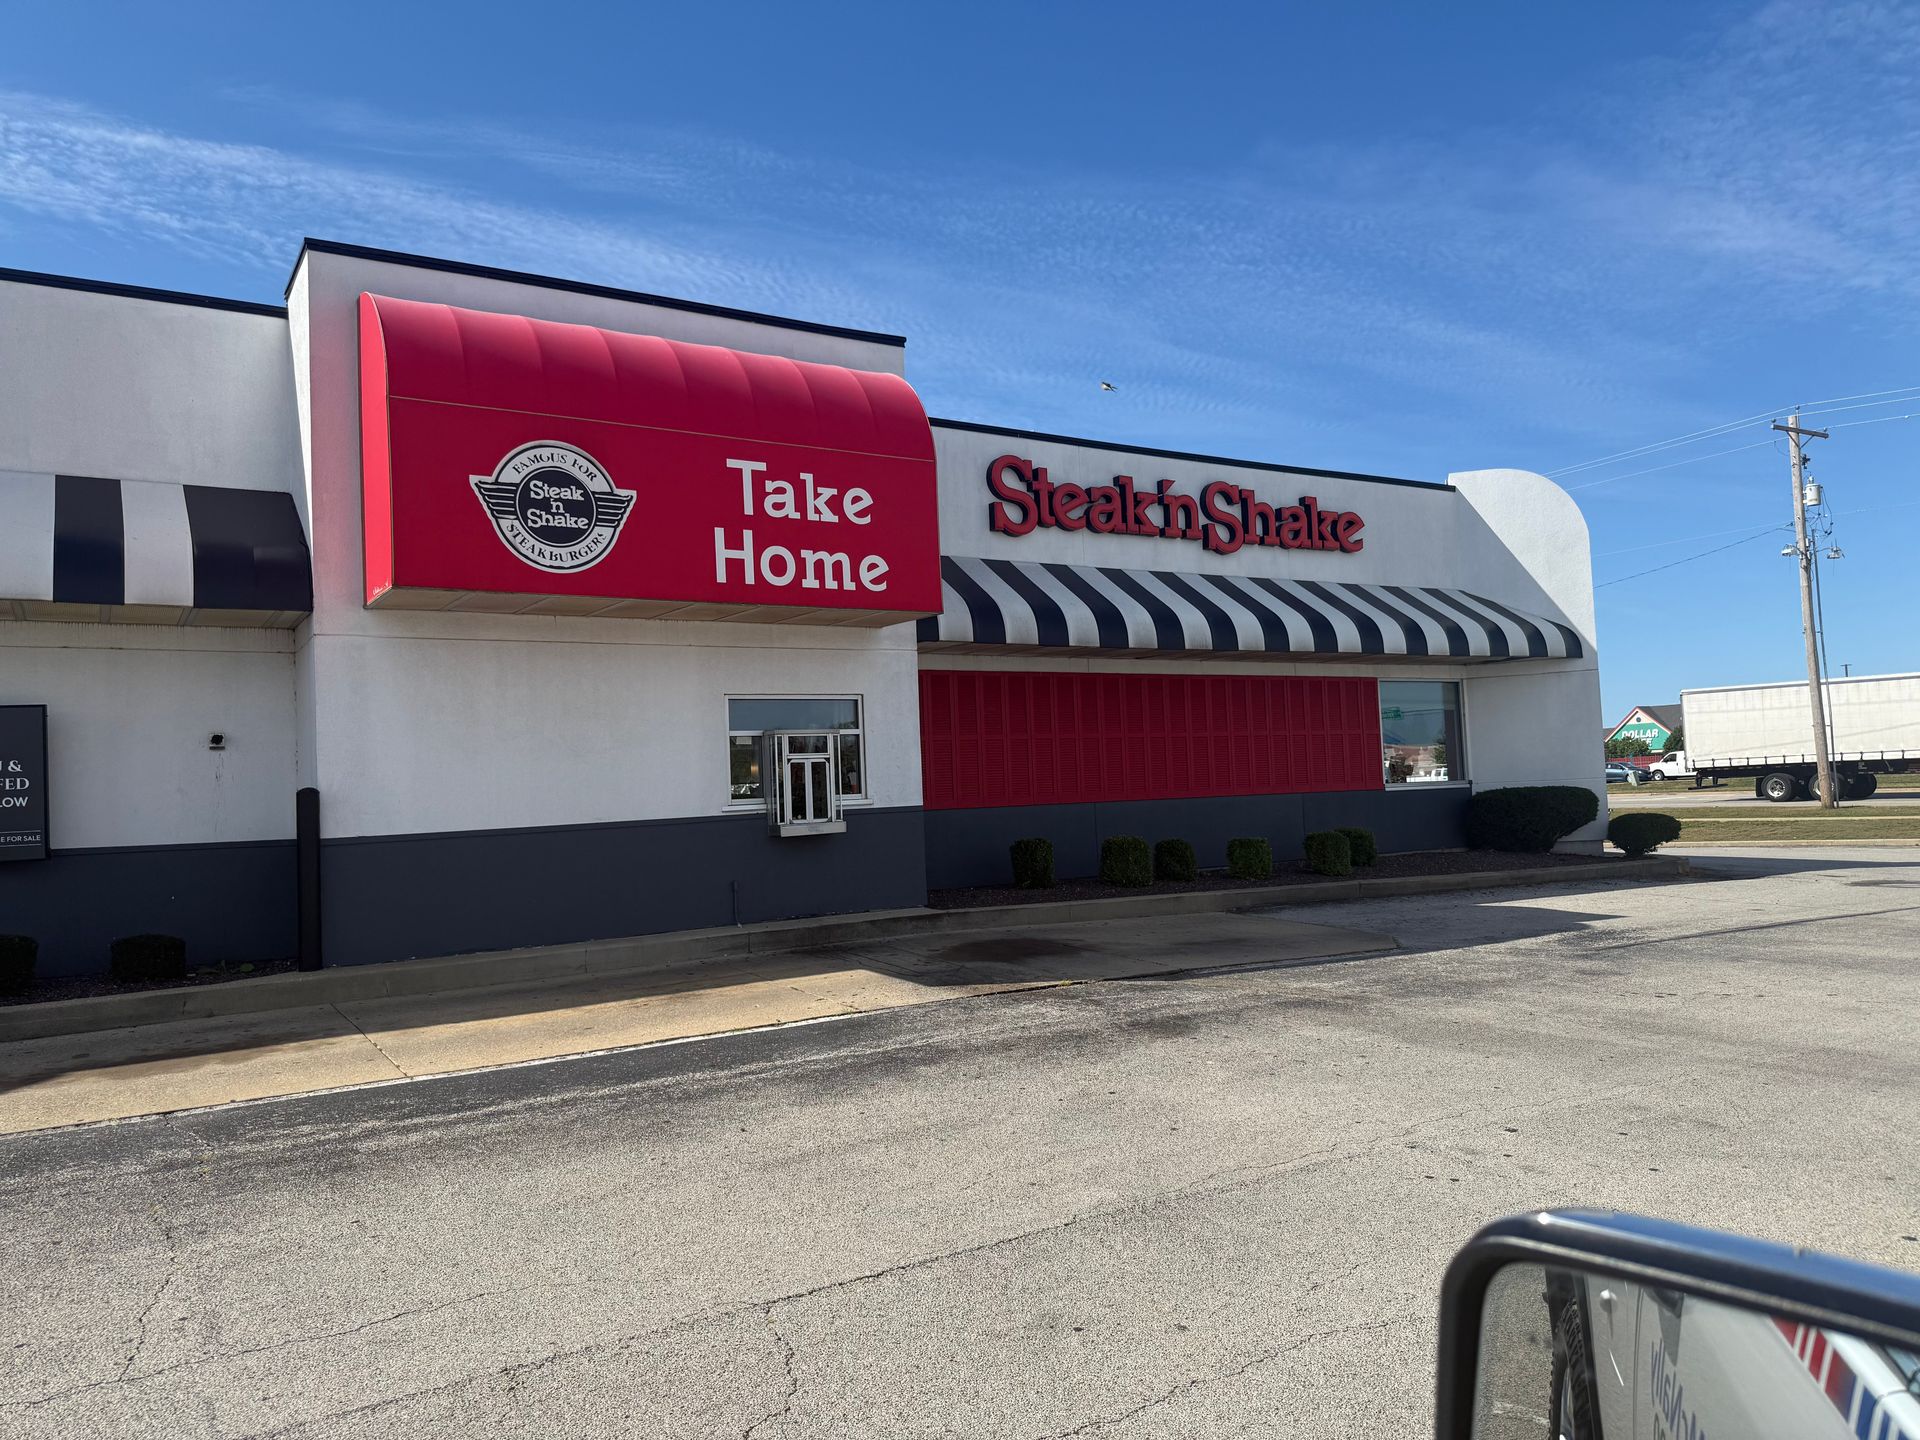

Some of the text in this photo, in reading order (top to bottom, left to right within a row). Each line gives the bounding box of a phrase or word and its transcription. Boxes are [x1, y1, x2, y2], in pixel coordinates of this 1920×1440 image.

[511, 452, 598, 482] FAMOUS FOR
[529, 480, 585, 501] Steak
[726, 458, 874, 525] Take
[526, 508, 589, 530] Shake
[506, 523, 607, 563] STEAKBURGERS
[714, 526, 890, 592] Home
[23, 834, 41, 842] SALE
